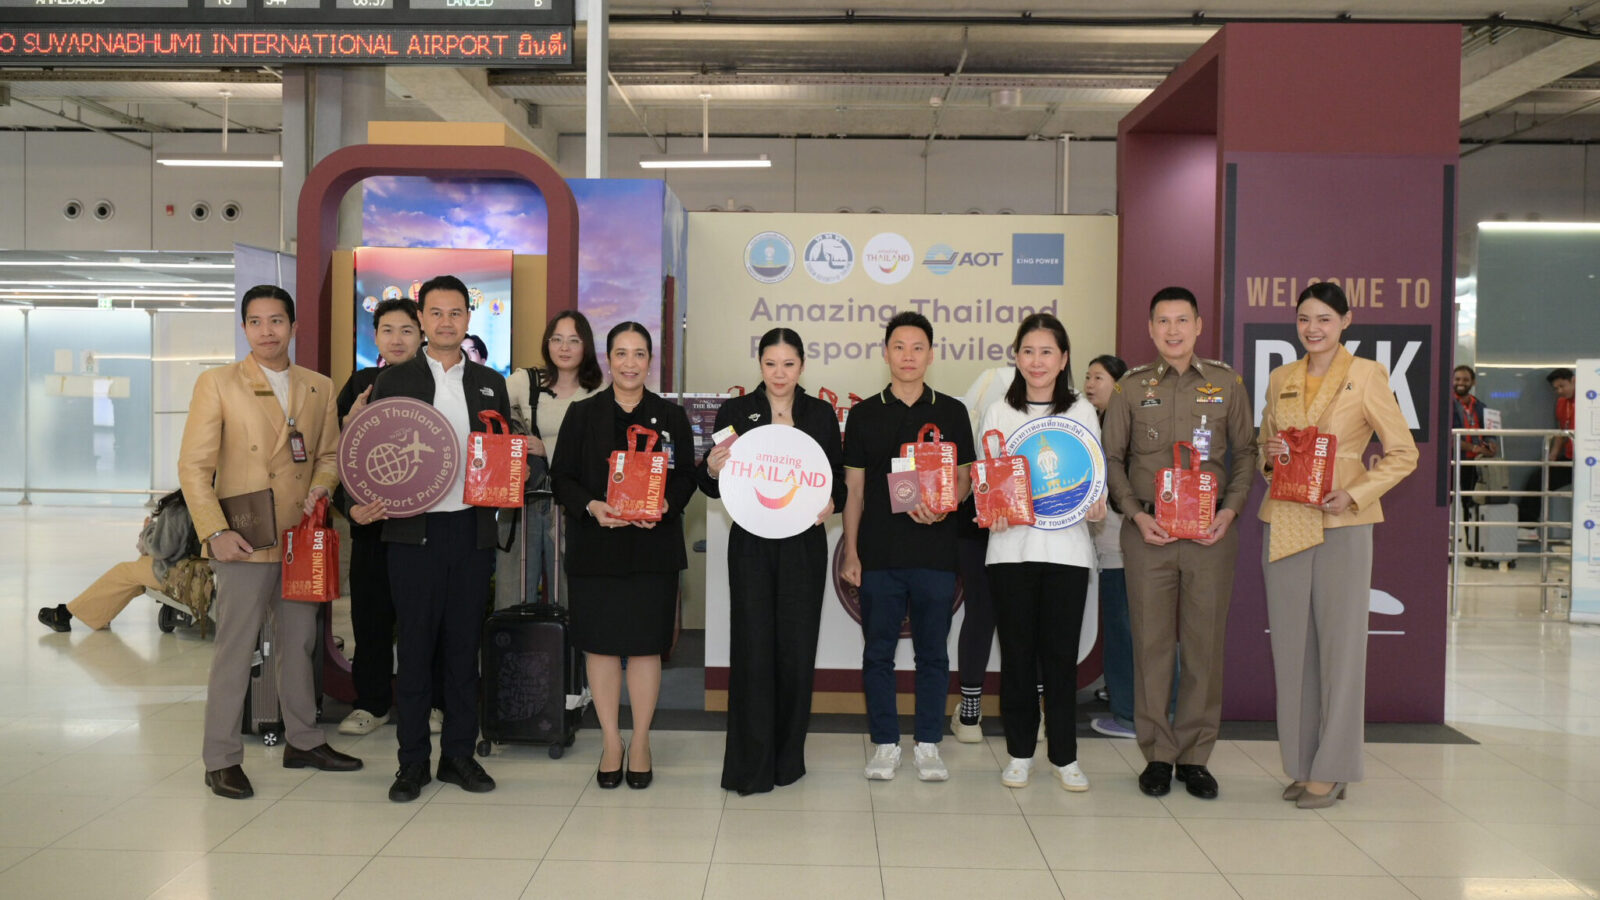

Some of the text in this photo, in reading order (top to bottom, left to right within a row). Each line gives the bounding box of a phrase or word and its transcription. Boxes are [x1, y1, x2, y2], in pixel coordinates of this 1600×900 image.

[23, 33, 201, 54] SUVARNABHUMI
[212, 33, 399, 55] INTERNATIONAL
[407, 35, 509, 56] AIRPORT
[518, 32, 567, 56] ยินดี
[958, 252, 1004, 267] AOT
[1246, 277, 1431, 309] WELME TO
[750, 297, 1058, 329] Amazing Thailand
[750, 336, 887, 366] Psport
[347, 407, 442, 469] Amazing Thailand
[508, 438, 523, 503] AMAZING BAG
[756, 453, 802, 469] amazing
[941, 445, 954, 465] BAG
[1011, 458, 1025, 476] BAG
[1307, 436, 1329, 502] AMAZING BAG
[416, 446, 453, 502] Privileges
[645, 455, 664, 516] AMAZING BAG
[729, 460, 826, 488] THAILAND
[1049, 515, 1077, 527] TOURISM
[1077, 505, 1091, 517] AND
[1088, 480, 1102, 508] SPORTS
[1199, 473, 1212, 534] AMAZING BAG
[312, 531, 325, 596] AMAZING BAG
